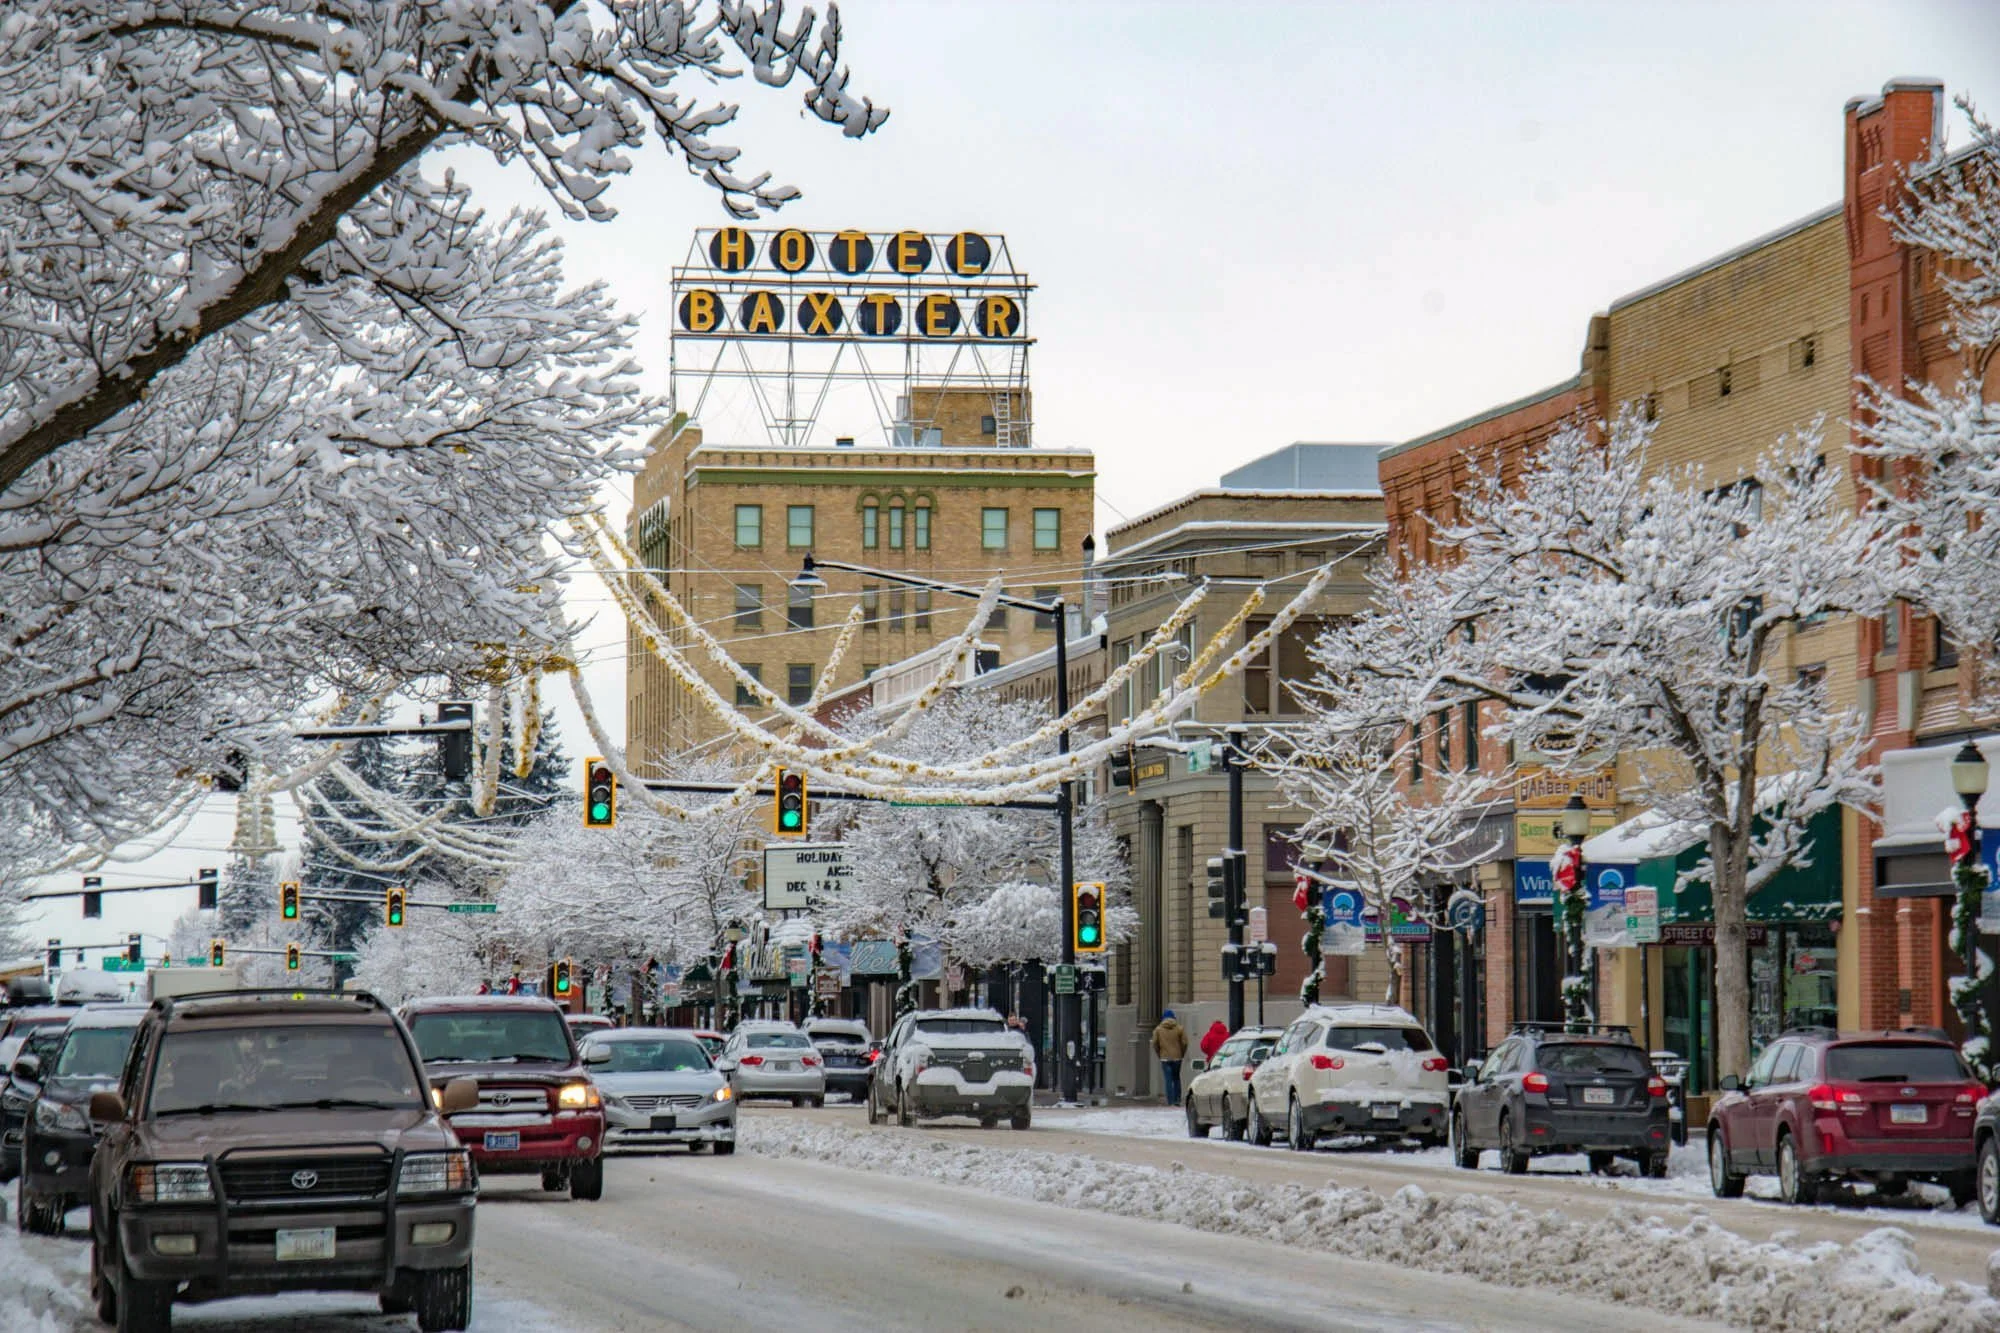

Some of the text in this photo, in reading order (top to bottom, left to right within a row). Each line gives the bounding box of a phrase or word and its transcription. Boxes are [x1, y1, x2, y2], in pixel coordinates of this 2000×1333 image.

[720, 228, 981, 273] HOTEL
[690, 289, 1011, 337] BAXTER
[1577, 774, 1613, 800] SHOP
[796, 852, 842, 864] HOLIDAY
[786, 881, 807, 892] DEC
[1664, 927, 1702, 939] STREET
